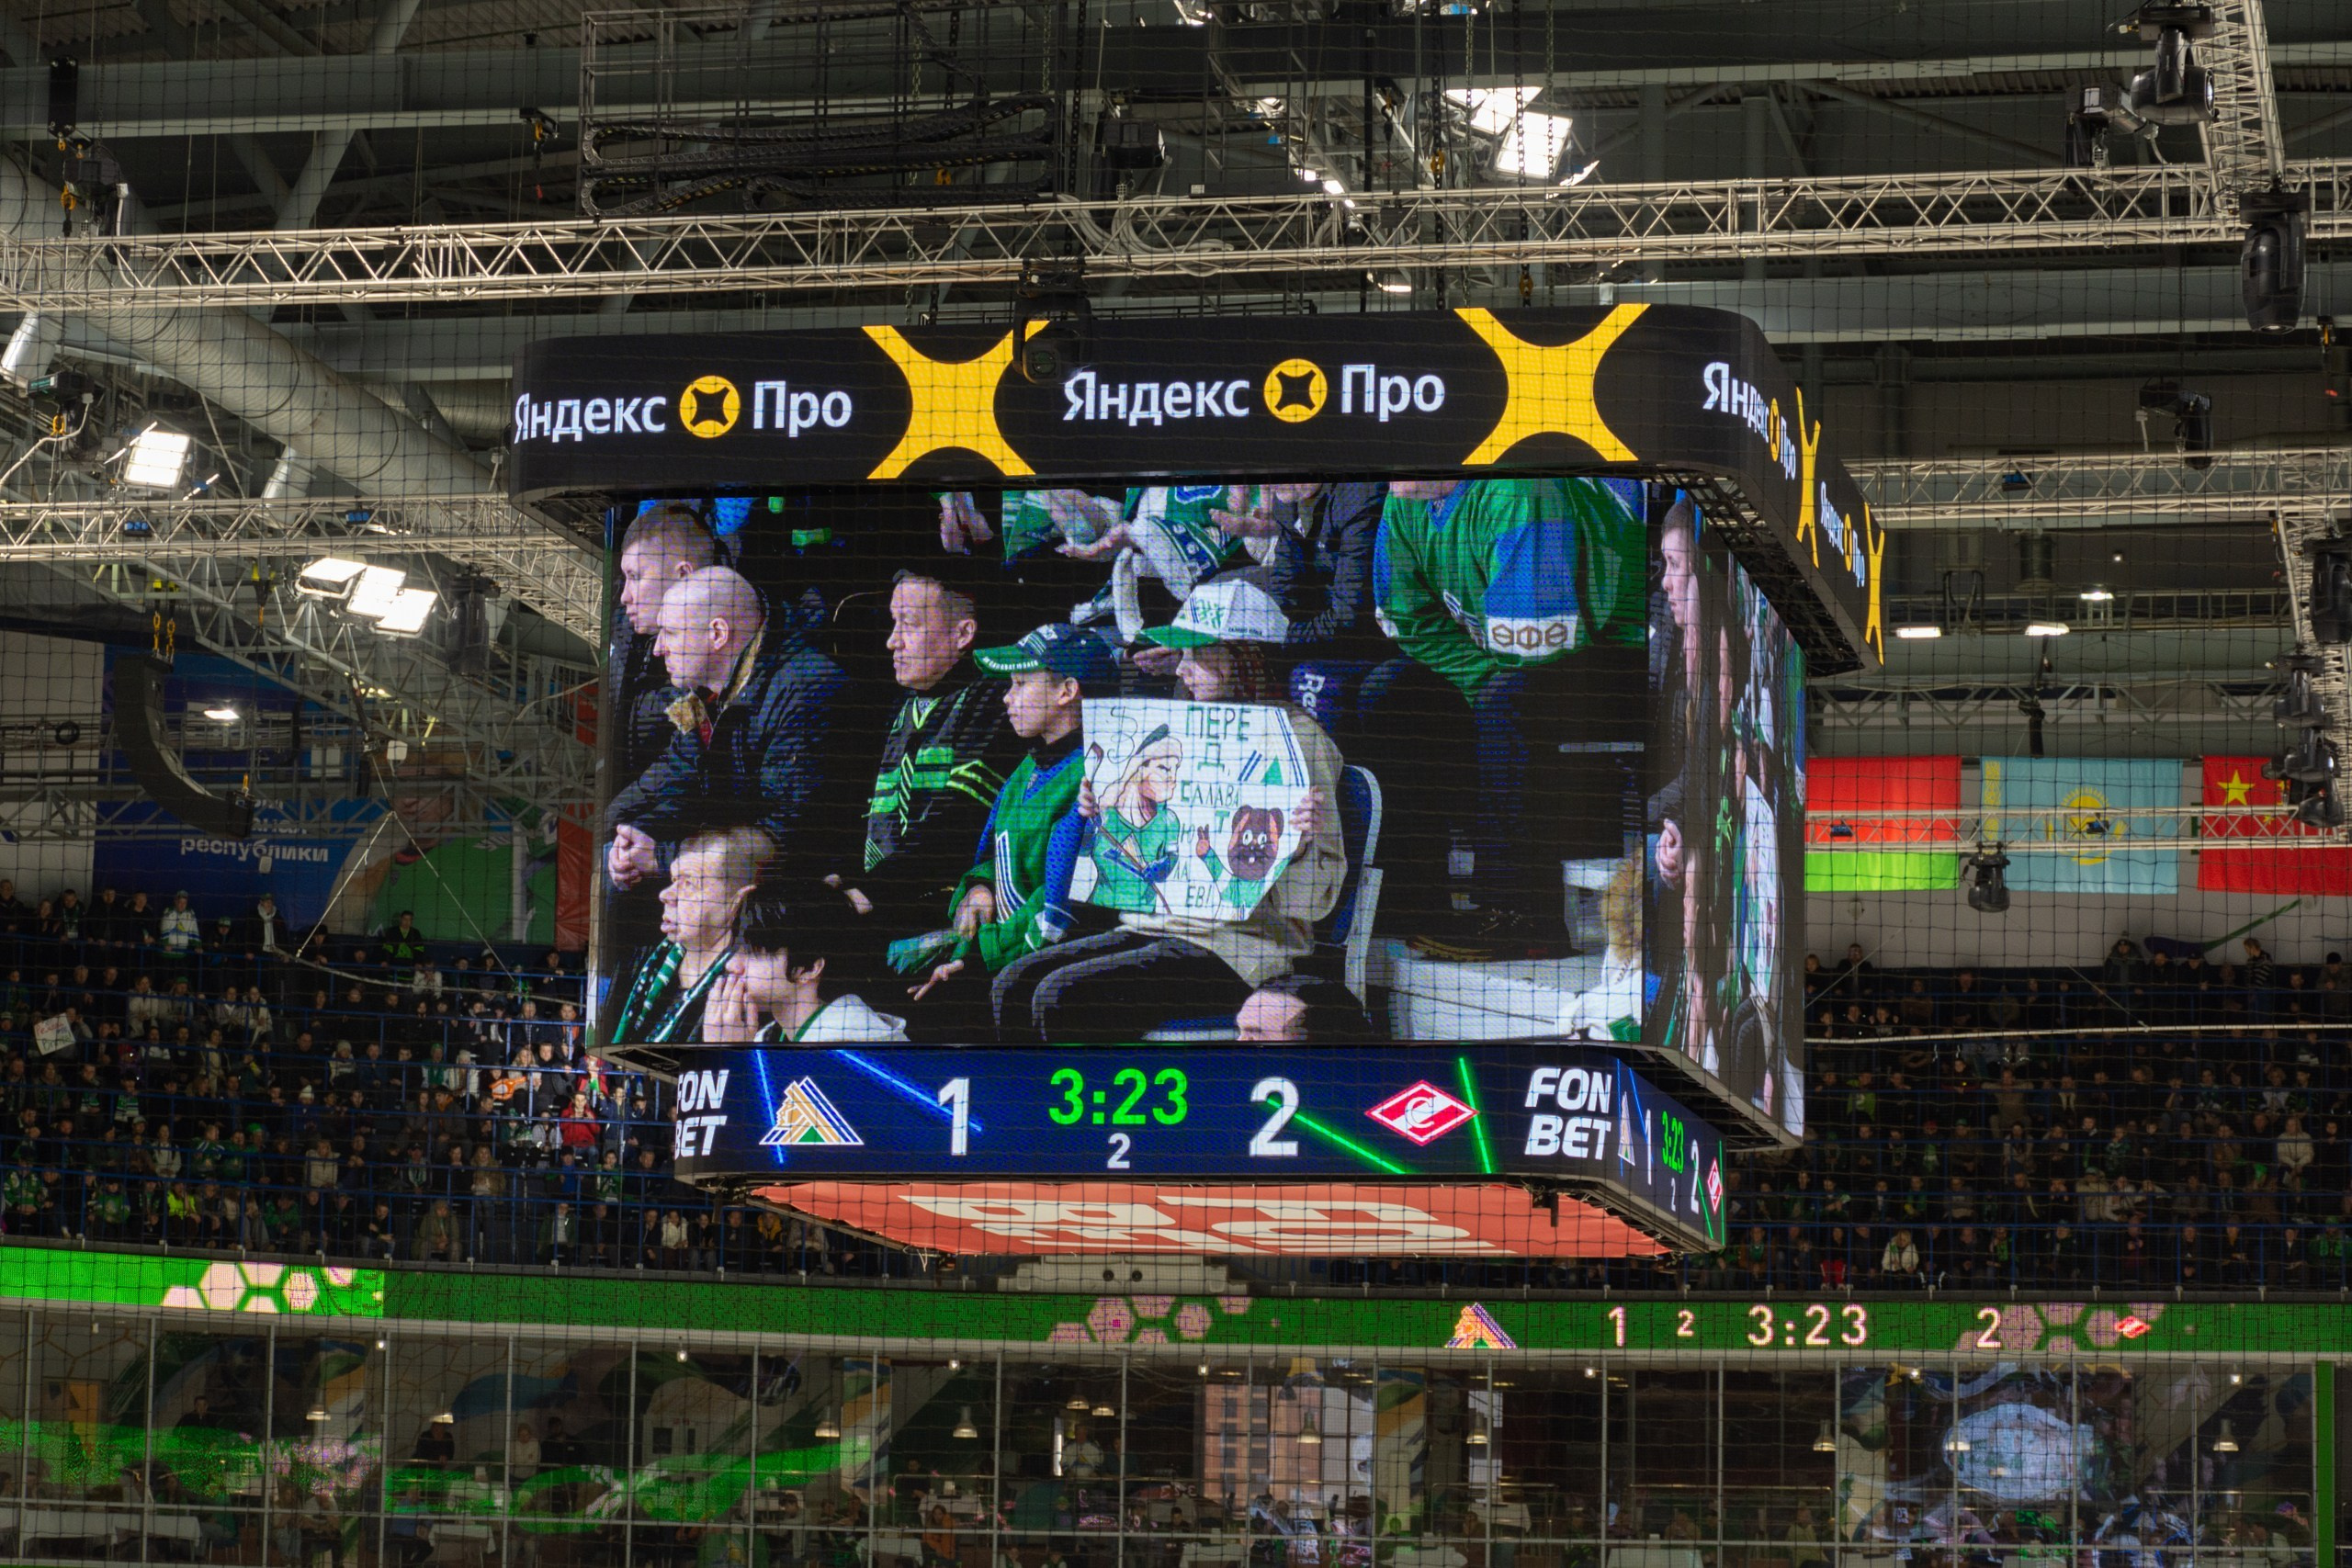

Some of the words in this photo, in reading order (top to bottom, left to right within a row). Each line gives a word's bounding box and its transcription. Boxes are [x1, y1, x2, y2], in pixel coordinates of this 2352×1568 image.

[514, 392, 667, 444] Яндекс
[753, 380, 853, 438] Про
[1062, 371, 1250, 426] Яндекс
[1340, 364, 1445, 422] Про
[1702, 362, 1770, 443] Яндекс
[1781, 416, 1796, 479] Про
[1185, 704, 1251, 741] ПЕРЕ
[181, 838, 329, 863] республики
[938, 1077, 969, 1156] 1
[1048, 1067, 1188, 1125] 3:23
[1249, 1077, 1300, 1157] 2
[1524, 1067, 1612, 1113] FON
[1106, 1133, 1132, 1169] 2
[1524, 1114, 1611, 1161] BET
[1662, 1111, 1684, 1175] 3:23
[1608, 1306, 1625, 1347] 1
[1677, 1309, 1695, 1337] 2
[1748, 1303, 1867, 1346] 3:23
[1977, 1307, 2002, 1348] 2
